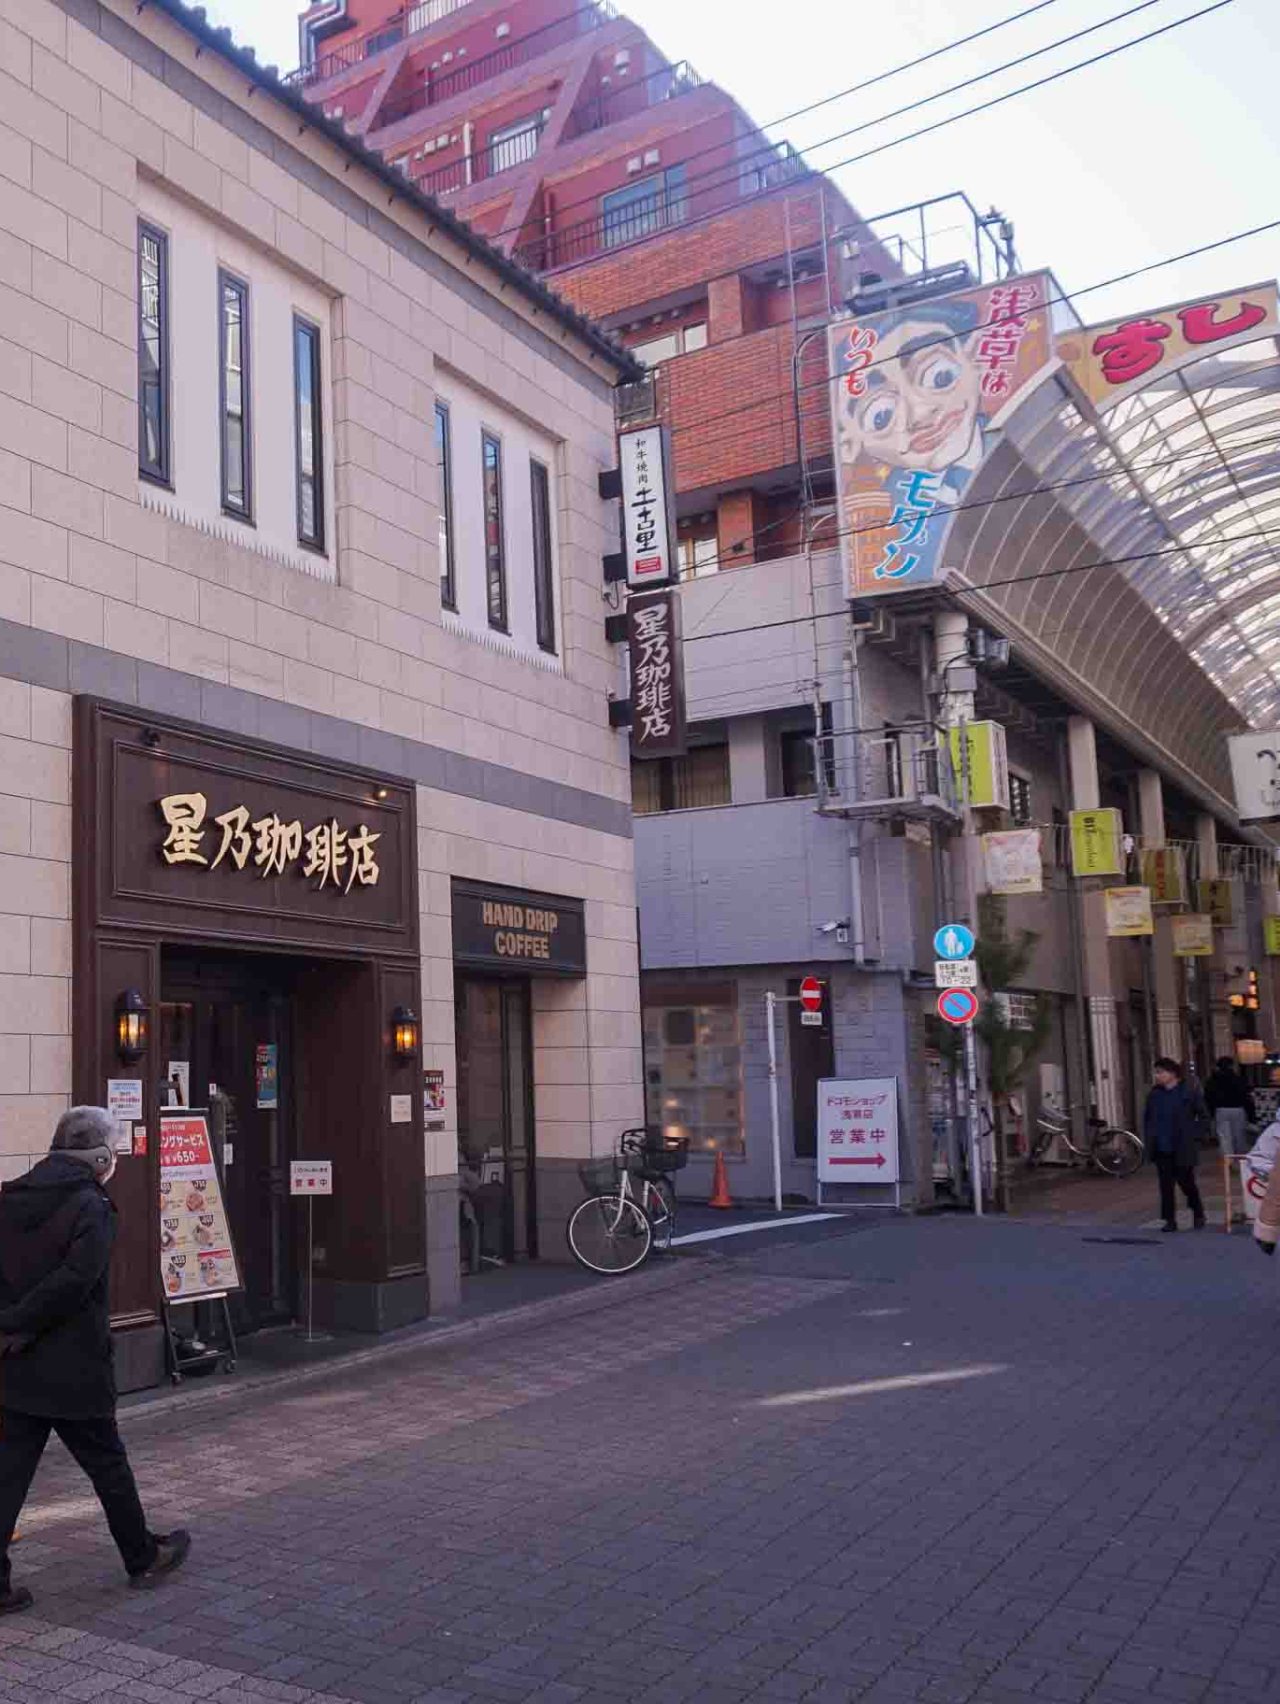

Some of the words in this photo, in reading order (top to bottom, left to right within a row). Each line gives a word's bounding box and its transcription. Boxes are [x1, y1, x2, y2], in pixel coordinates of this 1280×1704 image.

[844, 327, 878, 396] いつも
[1093, 302, 1267, 384] すし
[874, 468, 944, 580] モダン
[634, 603, 672, 744] 星乃珈琲店
[159, 792, 382, 894] 星乃珈琲店
[483, 901, 524, 928] HAND
[526, 909, 558, 933] DRIP
[495, 931, 550, 959] COFFEE
[830, 1128, 886, 1144] 営業中
